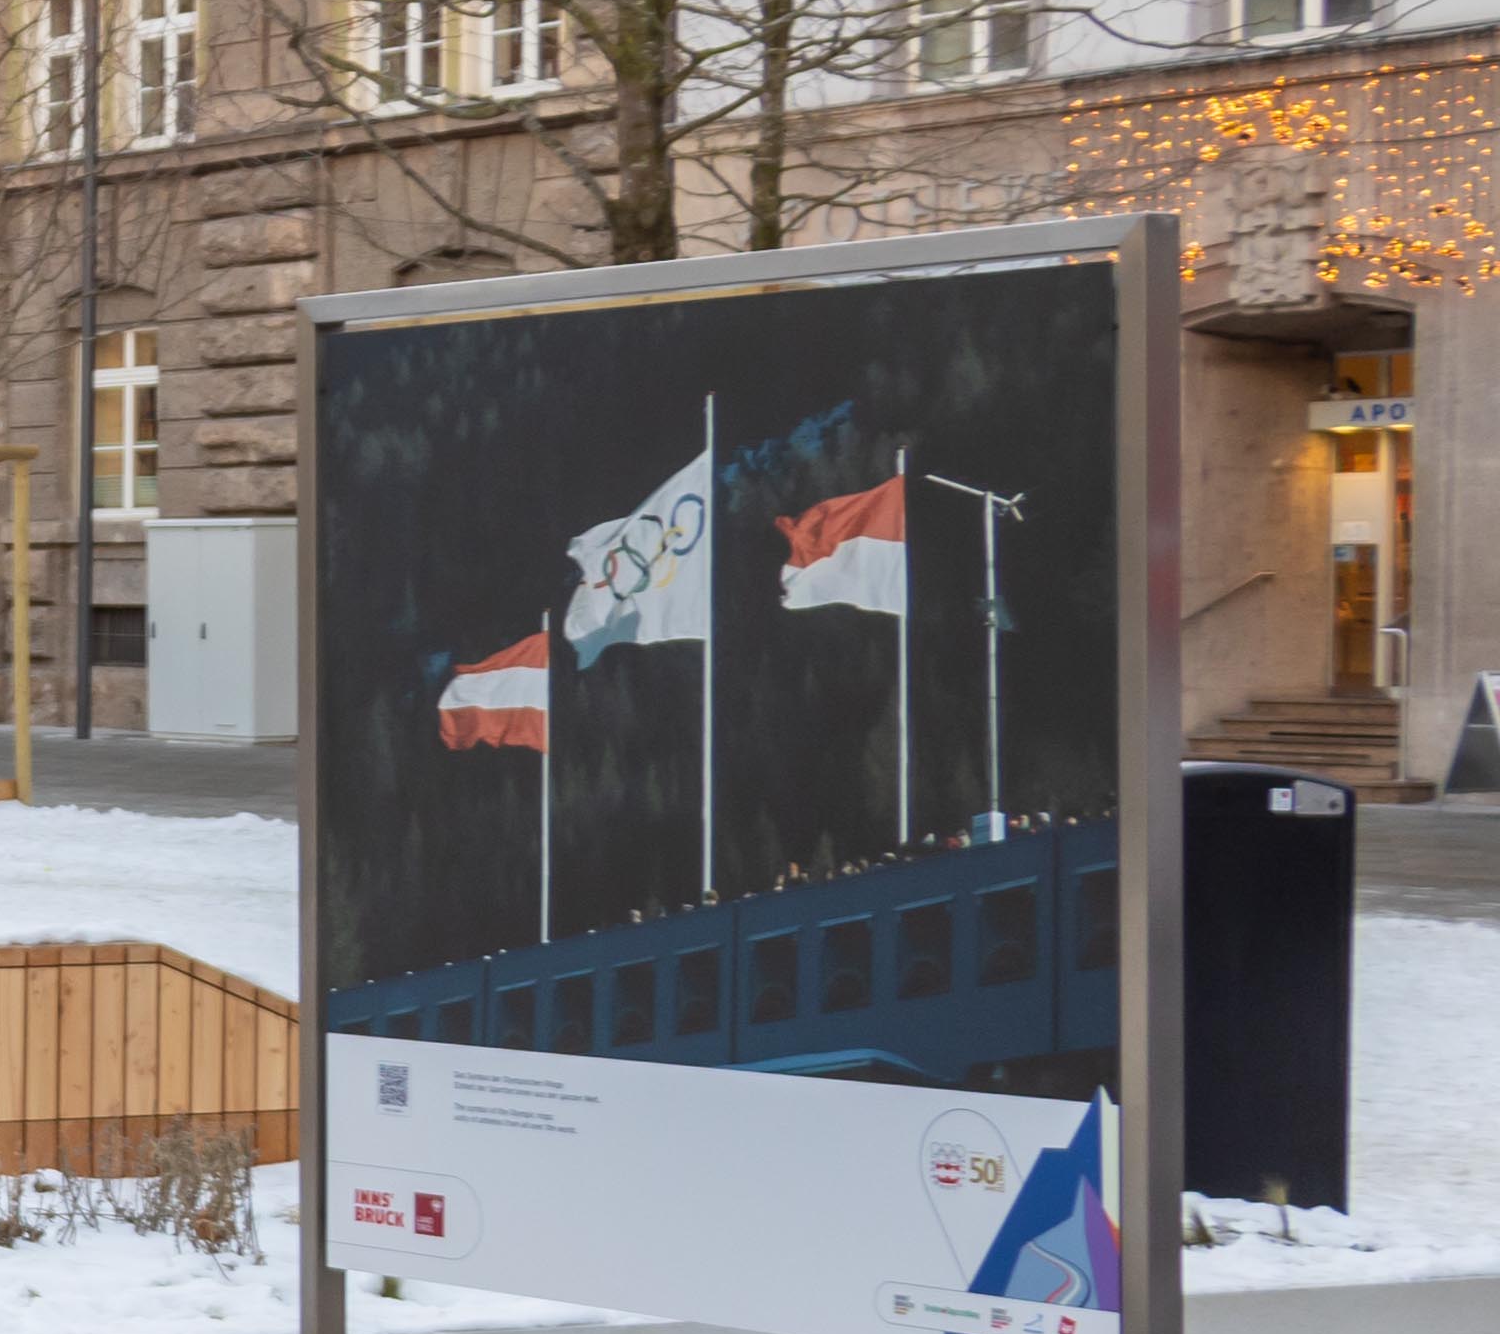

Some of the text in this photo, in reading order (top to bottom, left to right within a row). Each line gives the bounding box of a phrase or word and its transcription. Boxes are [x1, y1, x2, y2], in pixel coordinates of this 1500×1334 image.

[1350, 402, 1414, 422] APO
[969, 1157, 996, 1185] 50
[355, 1206, 404, 1227] BRUCK
